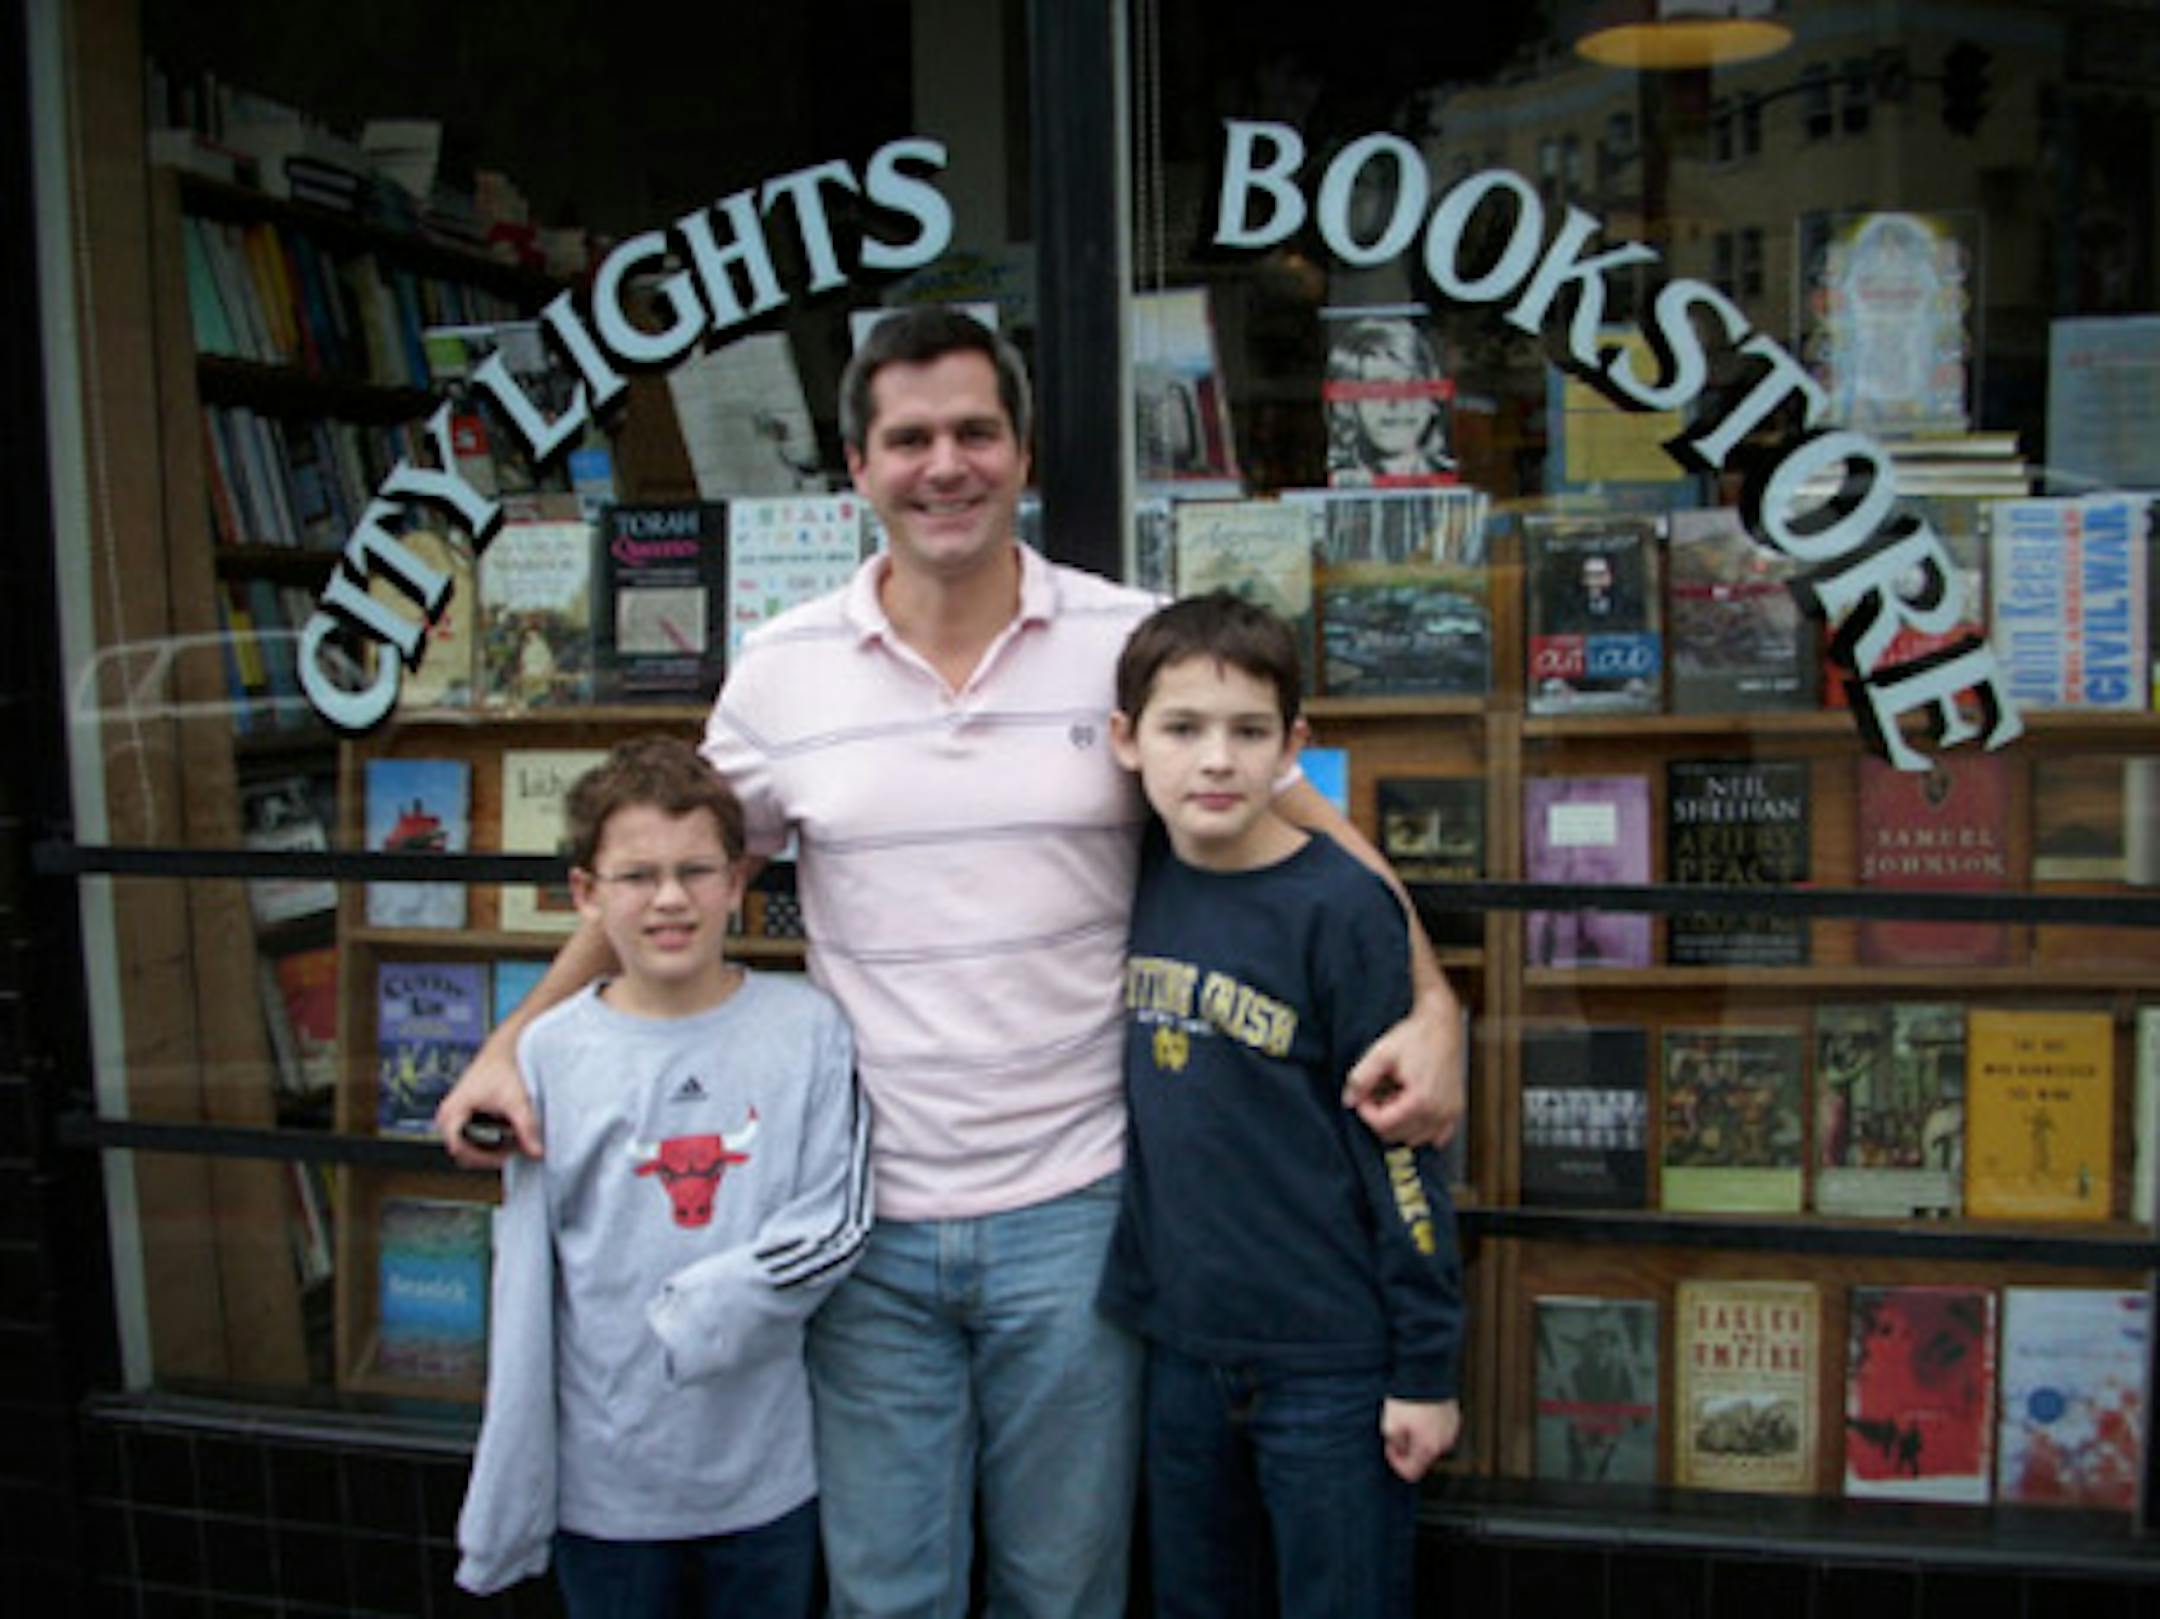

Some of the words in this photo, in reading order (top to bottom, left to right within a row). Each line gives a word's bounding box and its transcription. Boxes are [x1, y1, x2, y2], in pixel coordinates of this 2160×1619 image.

[299, 407, 500, 730] CITY
[473, 138, 953, 461] LIGHTS
[1214, 119, 2022, 772] BOOKSTORE
[2084, 502, 2129, 593] WAR
[2084, 596, 2129, 704] CIVIL
[1861, 854, 2007, 880] JOHNSON
[1878, 829, 1995, 848] SAMUEL
